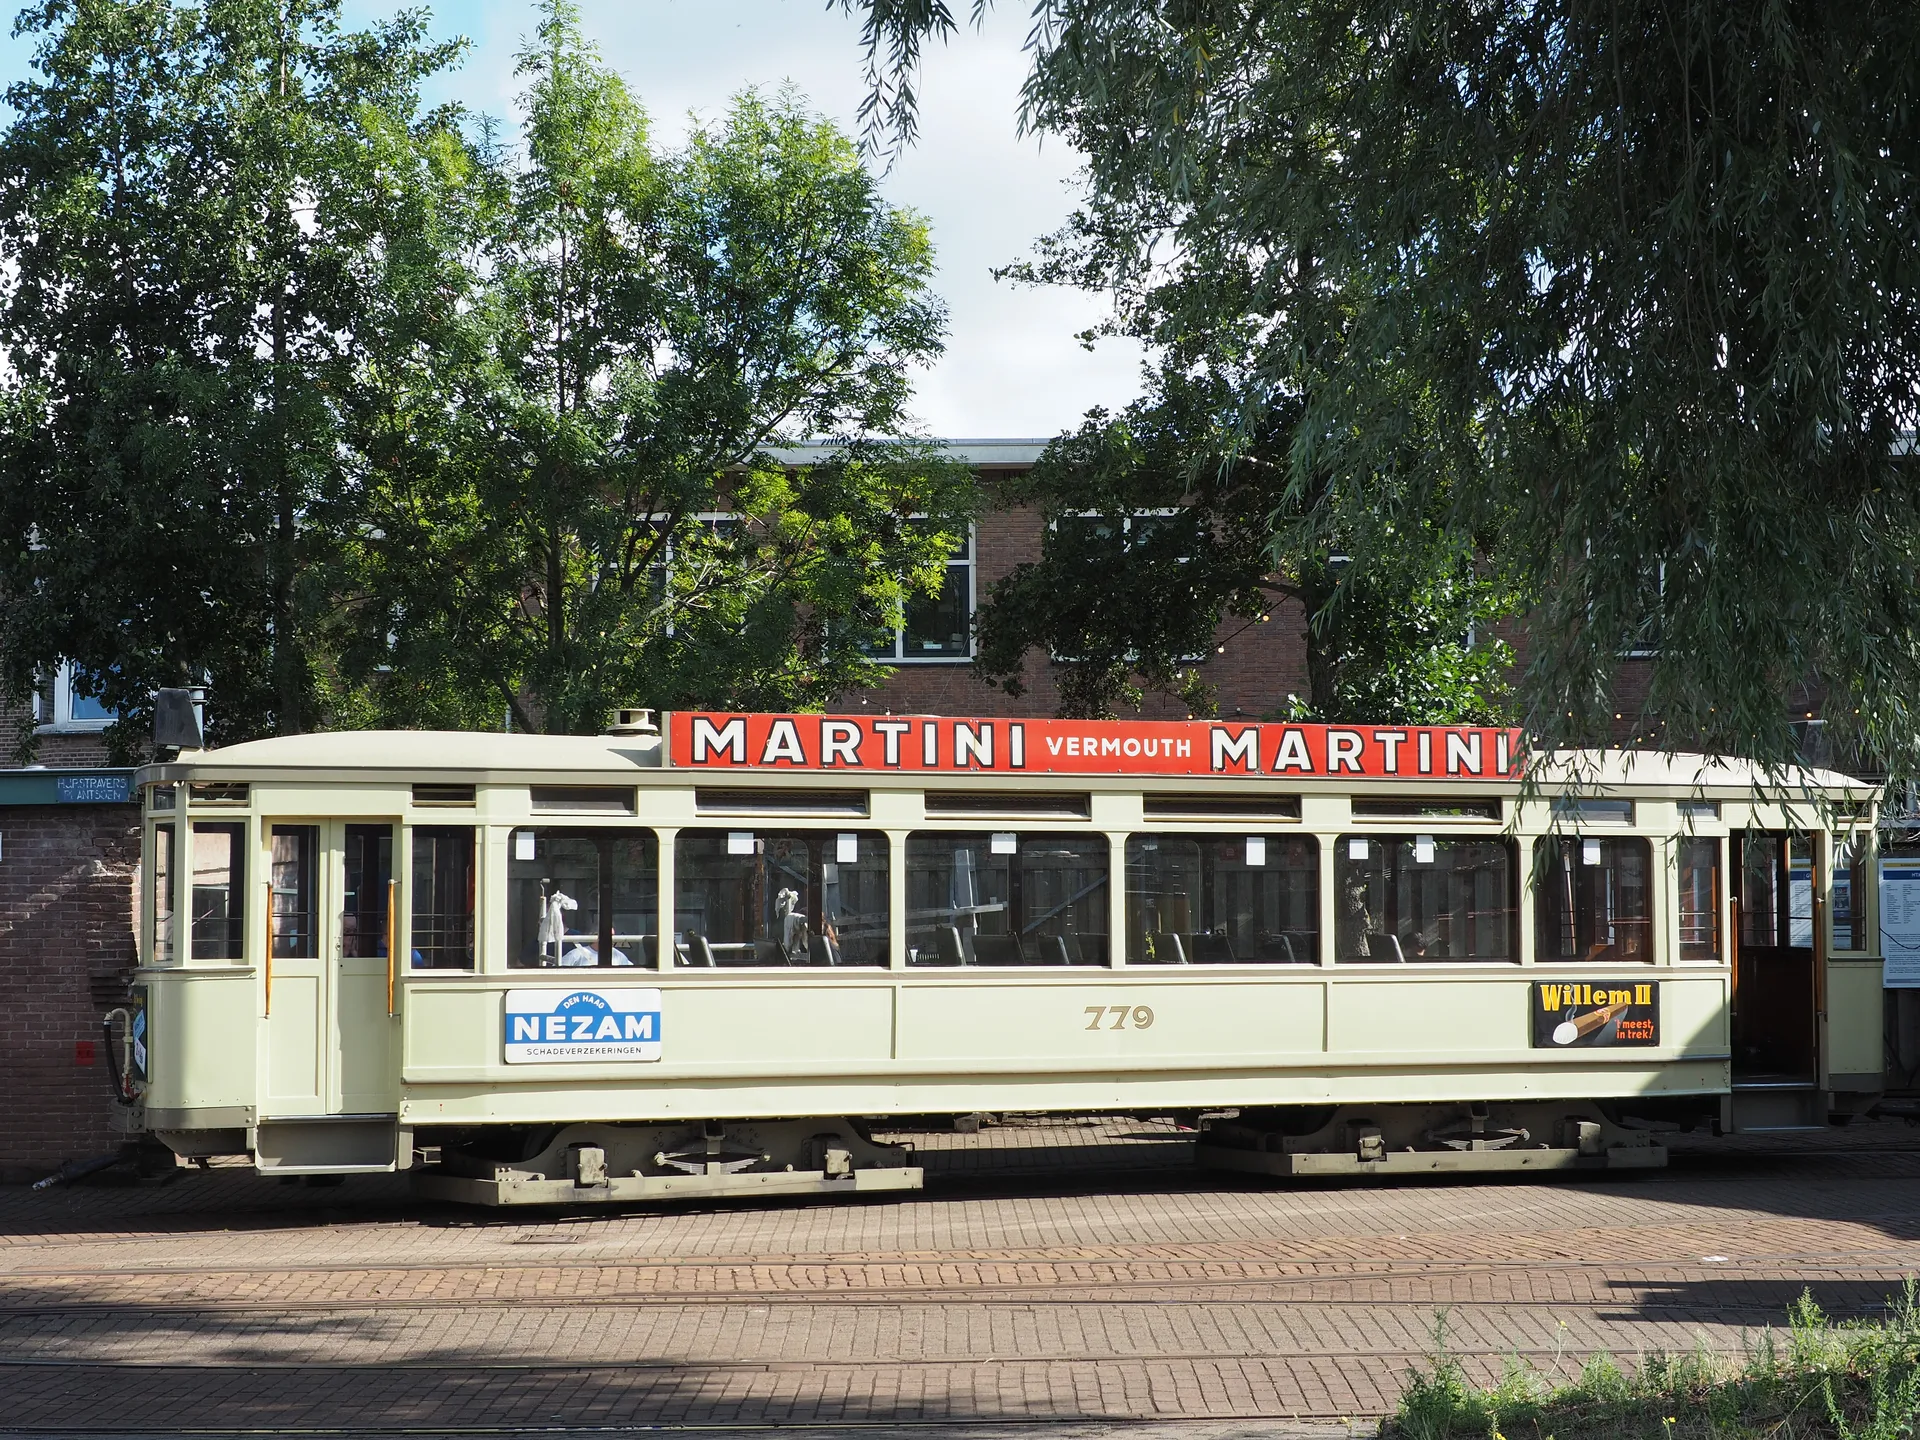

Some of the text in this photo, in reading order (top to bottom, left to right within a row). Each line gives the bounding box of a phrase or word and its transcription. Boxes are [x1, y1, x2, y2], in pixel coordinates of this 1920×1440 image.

[691, 716, 1510, 775] MARTINI VERMOUTH MARTINI
[563, 994, 605, 1010] DEN HAAG
[1540, 984, 1632, 1011] Willem
[514, 1015, 652, 1041] NEZAM
[1084, 1005, 1155, 1030] 779
[1616, 1029, 1626, 1040] in
[526, 1047, 642, 1056] SCHADEVERZEKERINGEN
